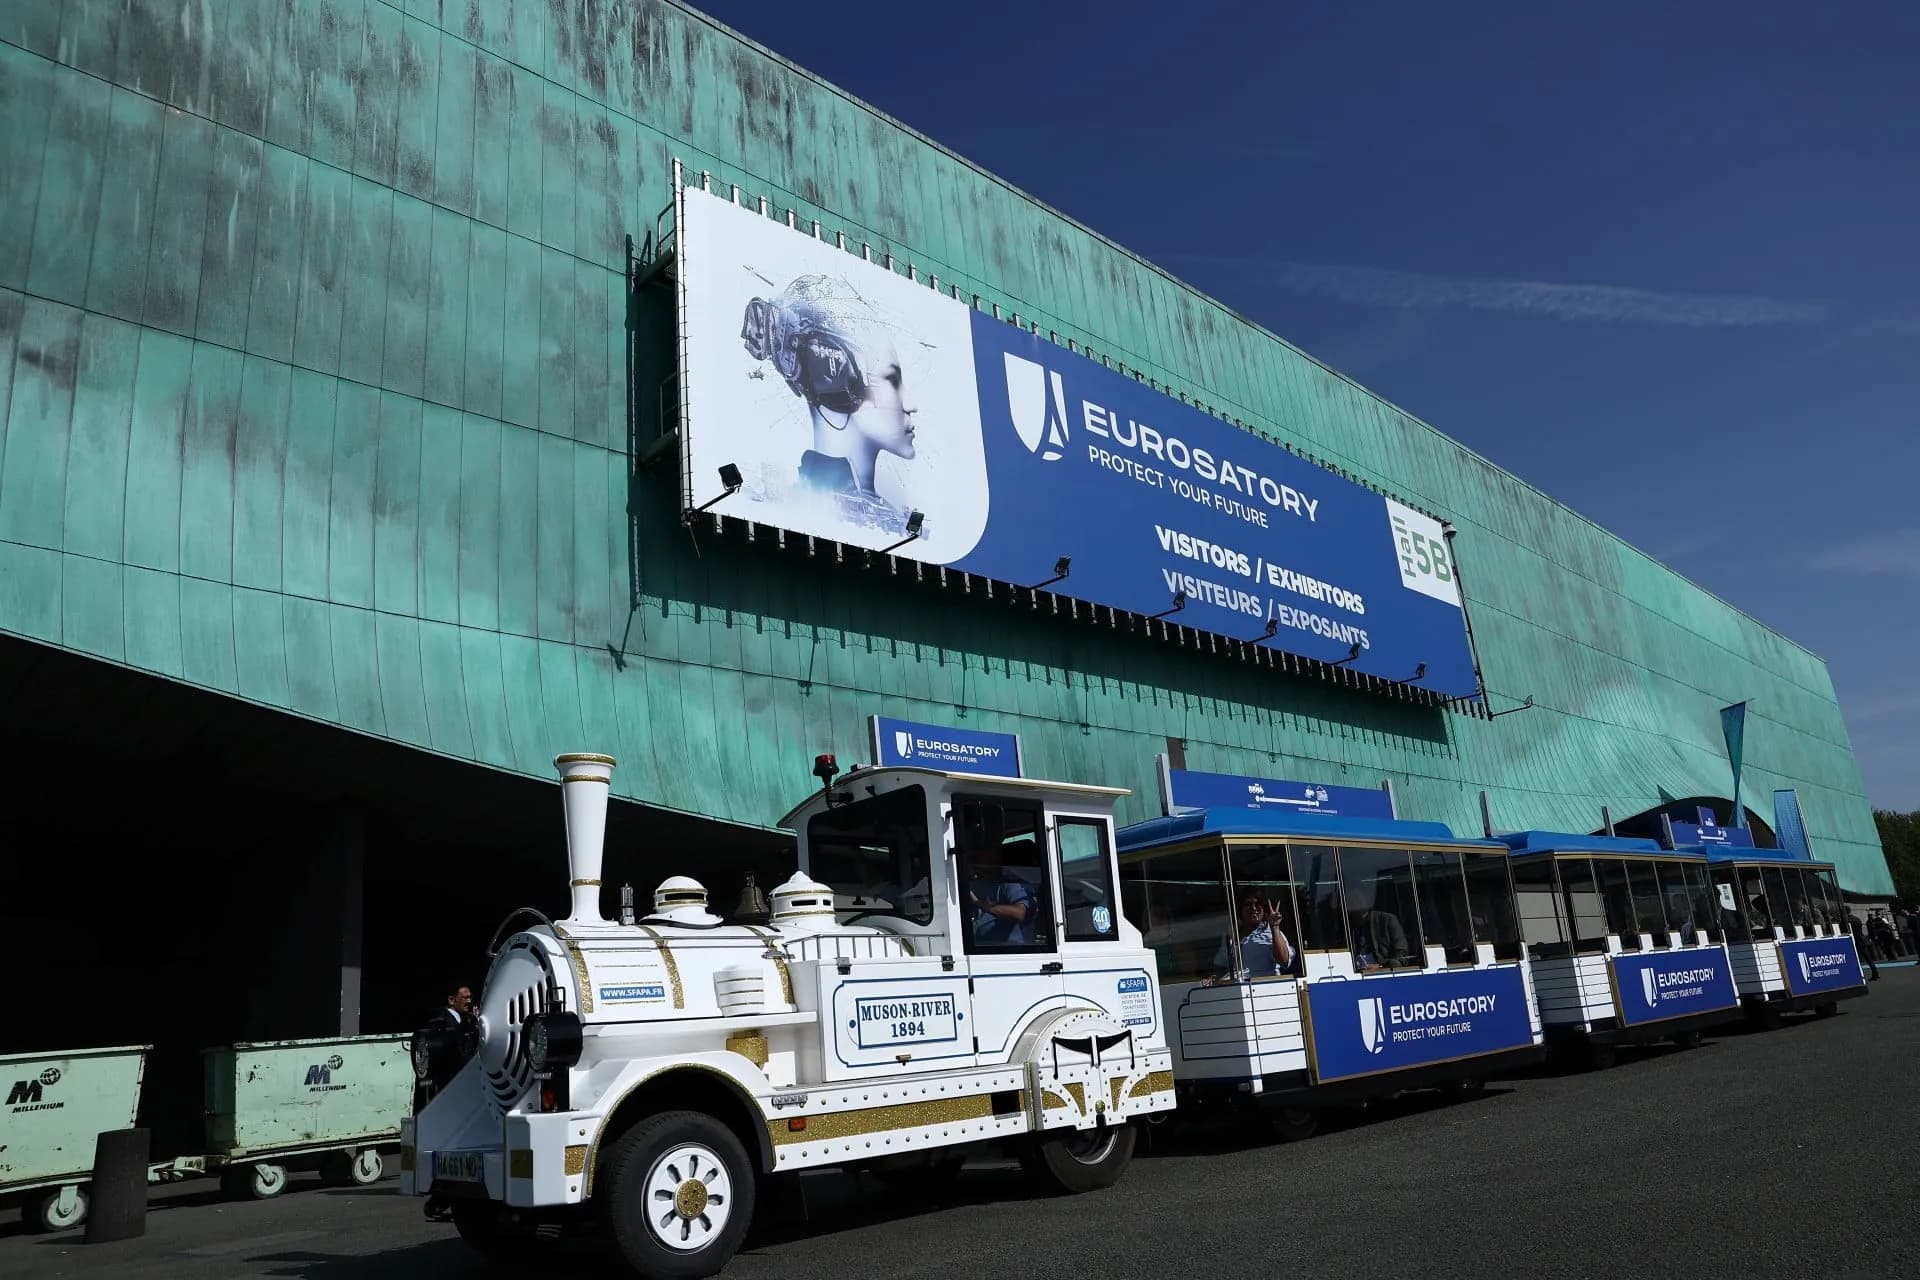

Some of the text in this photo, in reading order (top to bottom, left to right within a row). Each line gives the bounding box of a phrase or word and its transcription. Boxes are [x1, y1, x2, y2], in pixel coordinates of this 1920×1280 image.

[1082, 400, 1319, 522] EUROSATORY
[1088, 445, 1269, 529] PROTECT YOUR FUTURE
[1393, 516, 1417, 578] Hall
[1411, 531, 1451, 582] 5B
[1154, 524, 1251, 577] VISITORS
[1266, 563, 1365, 615] EXHIBITORS
[1162, 568, 1263, 618] VISITEURS
[1278, 604, 1370, 650] EXPOSANTS
[917, 739, 1000, 757] EUROSATORY
[918, 751, 941, 759] PROTECT
[957, 755, 977, 763] FUTURE
[1808, 953, 1846, 967] EUROSATORY
[1126, 978, 1146, 988] SFAPA
[1658, 967, 1714, 987] EUROSATORY
[602, 987, 663, 998] WWW.SFAPA.FR
[1390, 995, 1496, 1024] EUROSATORY
[891, 1021, 926, 1038] 1894
[1392, 1021, 1472, 1043] PROTECT YOUR FUTURE
[309, 1084, 347, 1093] MILLENIUM
[12, 1102, 64, 1113] MILLENIUM
